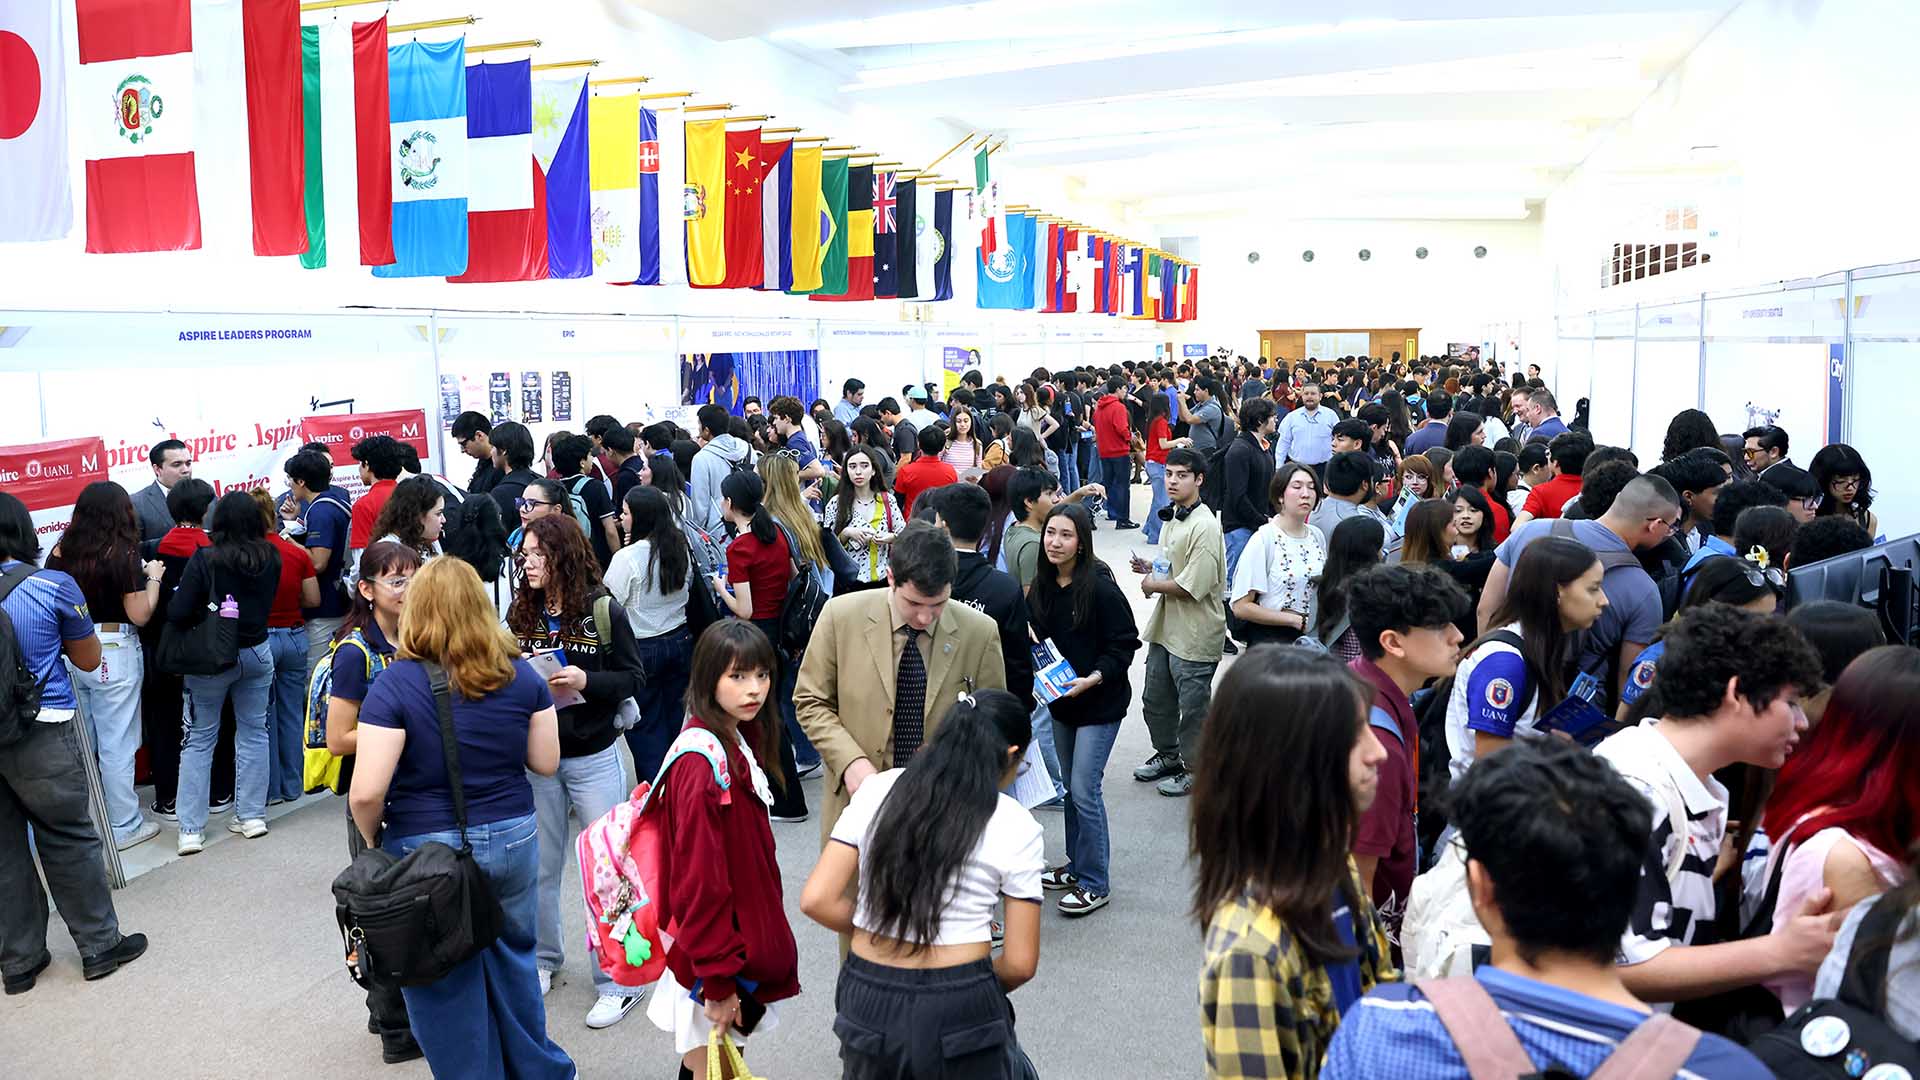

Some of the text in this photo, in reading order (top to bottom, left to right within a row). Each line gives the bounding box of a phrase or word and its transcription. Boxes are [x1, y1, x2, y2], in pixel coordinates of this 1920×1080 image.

[178, 329, 312, 341] ASPIRE LEADERS PROGRAM
[170, 429, 237, 463] spire
[43, 464, 72, 478] UANL
[1482, 708, 1509, 723] UANL
